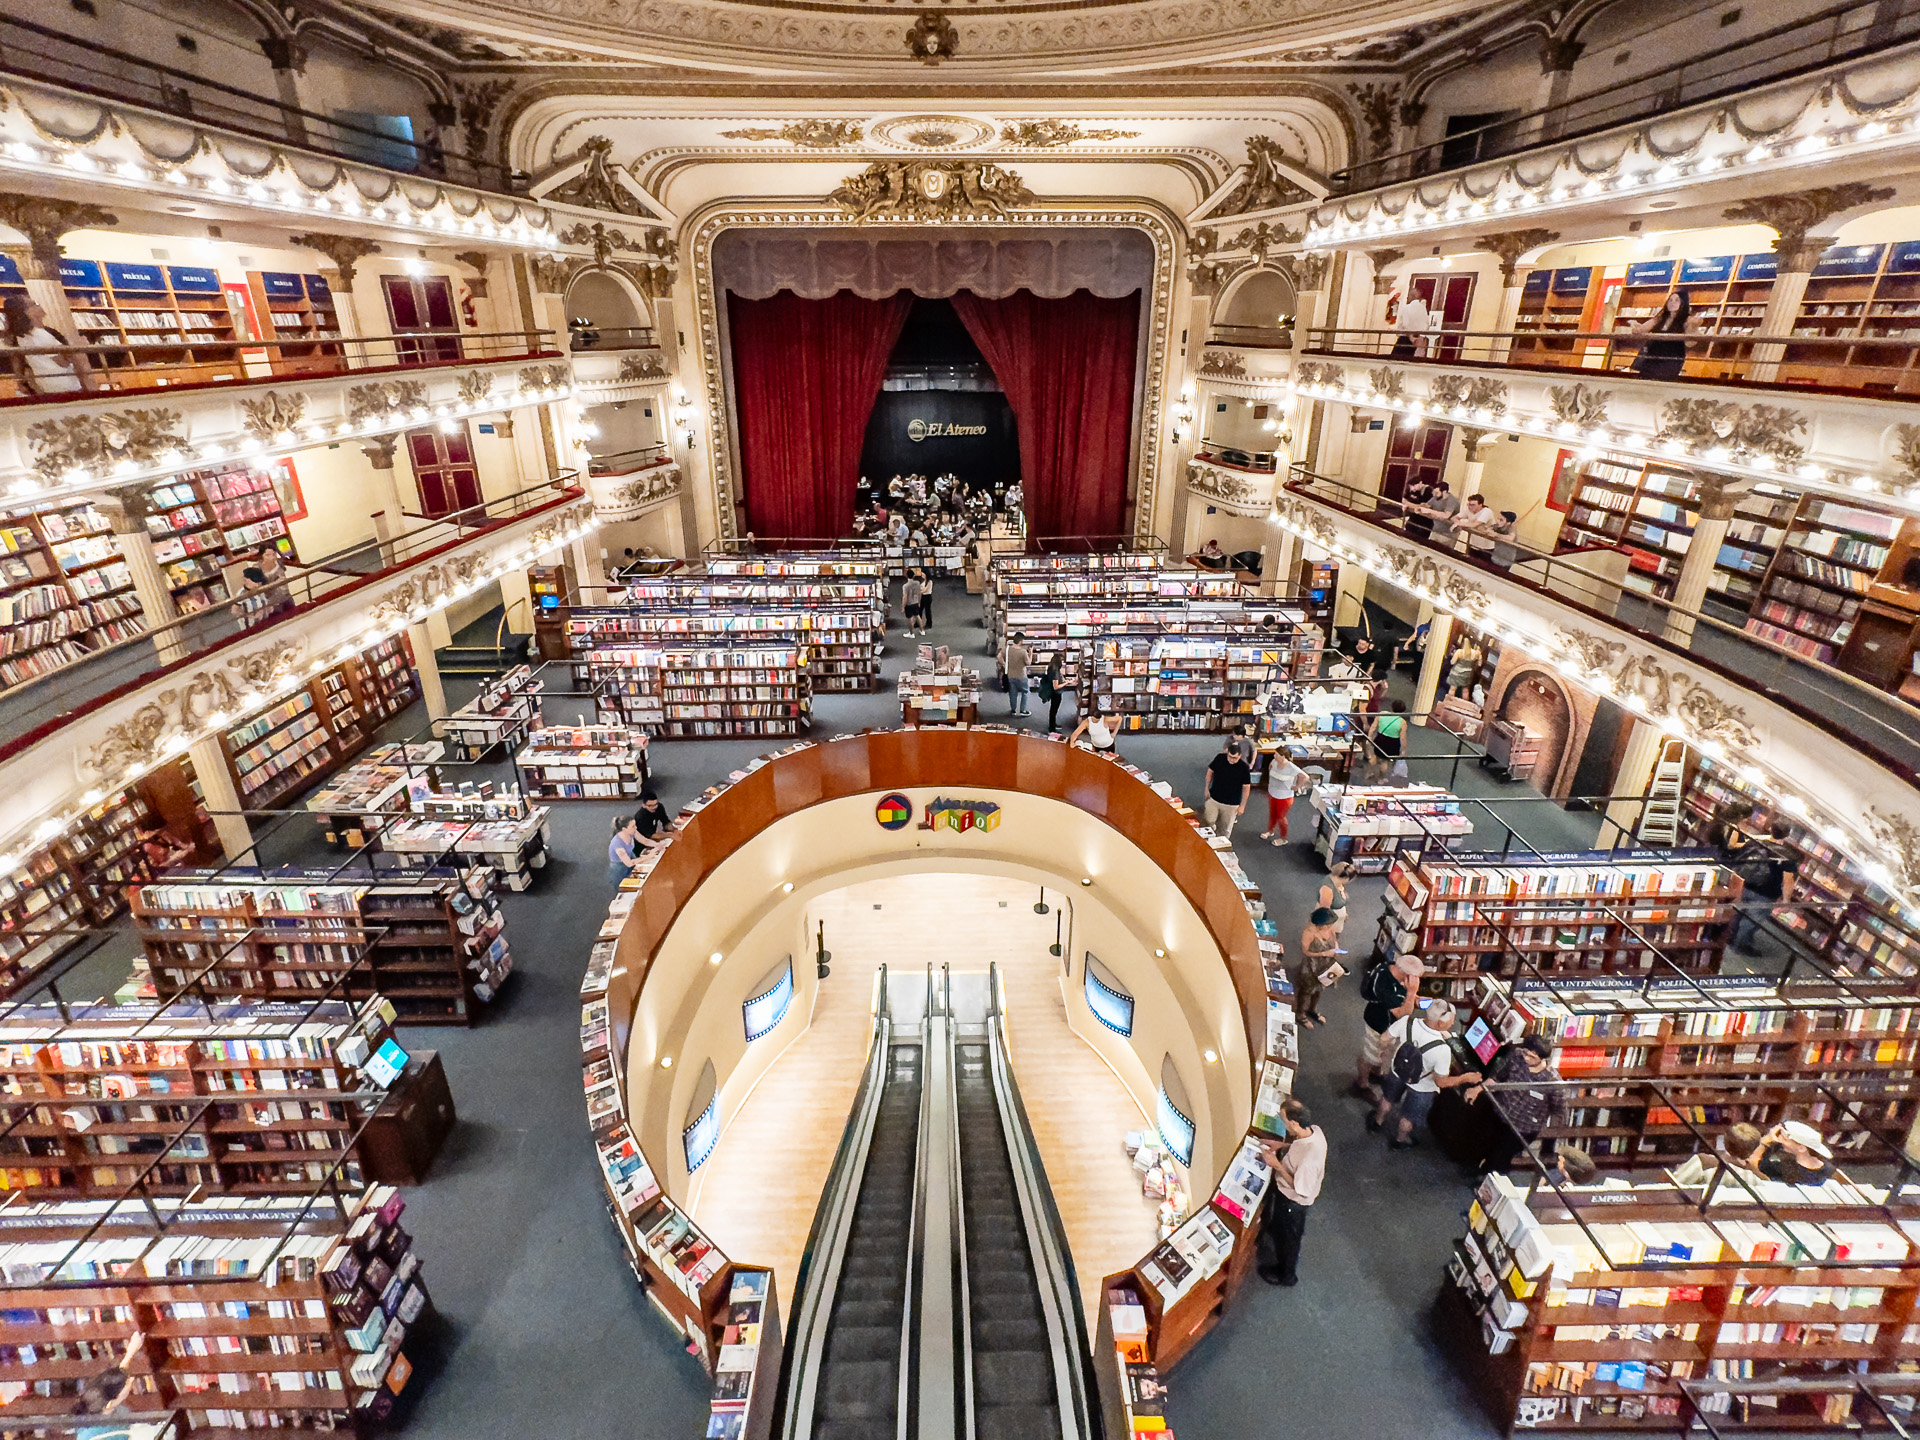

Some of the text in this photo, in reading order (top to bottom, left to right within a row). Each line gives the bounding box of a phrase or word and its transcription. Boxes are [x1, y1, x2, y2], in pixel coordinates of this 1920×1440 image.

[926, 422, 988, 437] El Ateneo
[1566, 979, 1635, 987] INTERNACIONAL
[1700, 977, 1768, 986] INTERNACIONAL
[1591, 1194, 1638, 1203] EMPRESA
[177, 1211, 318, 1221] LITERATURA ARGENTNA
